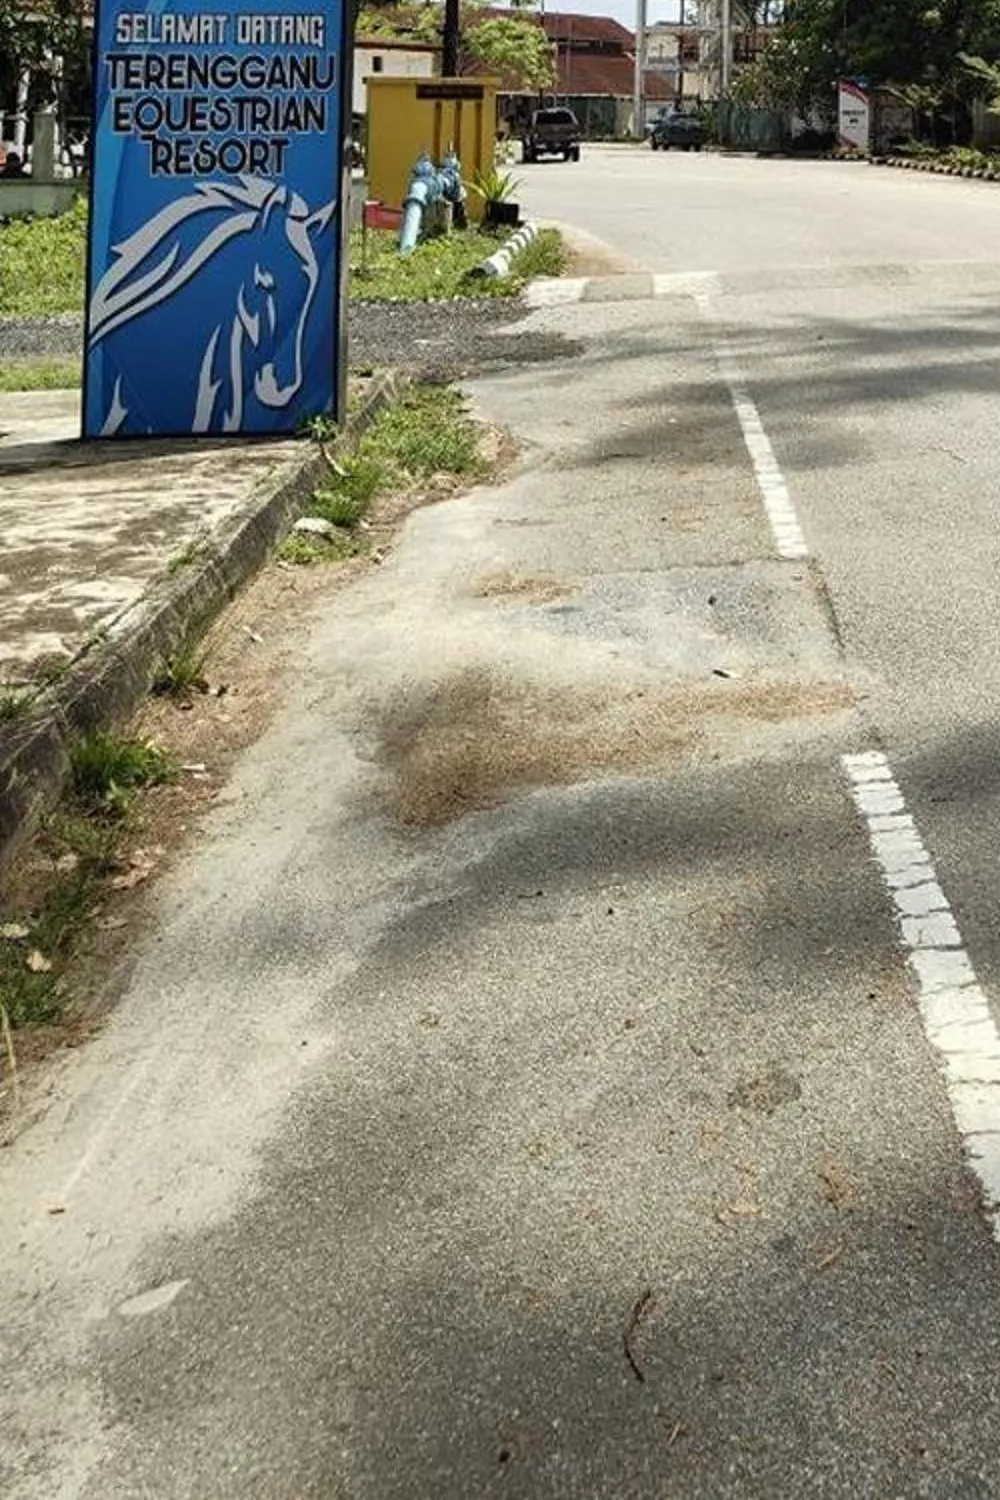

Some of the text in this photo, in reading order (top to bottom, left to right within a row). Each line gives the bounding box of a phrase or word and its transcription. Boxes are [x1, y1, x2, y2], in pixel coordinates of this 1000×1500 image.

[115, 13, 228, 44] SELAMAT
[105, 53, 336, 91] TERENGGANU
[112, 96, 325, 133] EQUESTRIAN
[142, 134, 290, 176] RESORT
